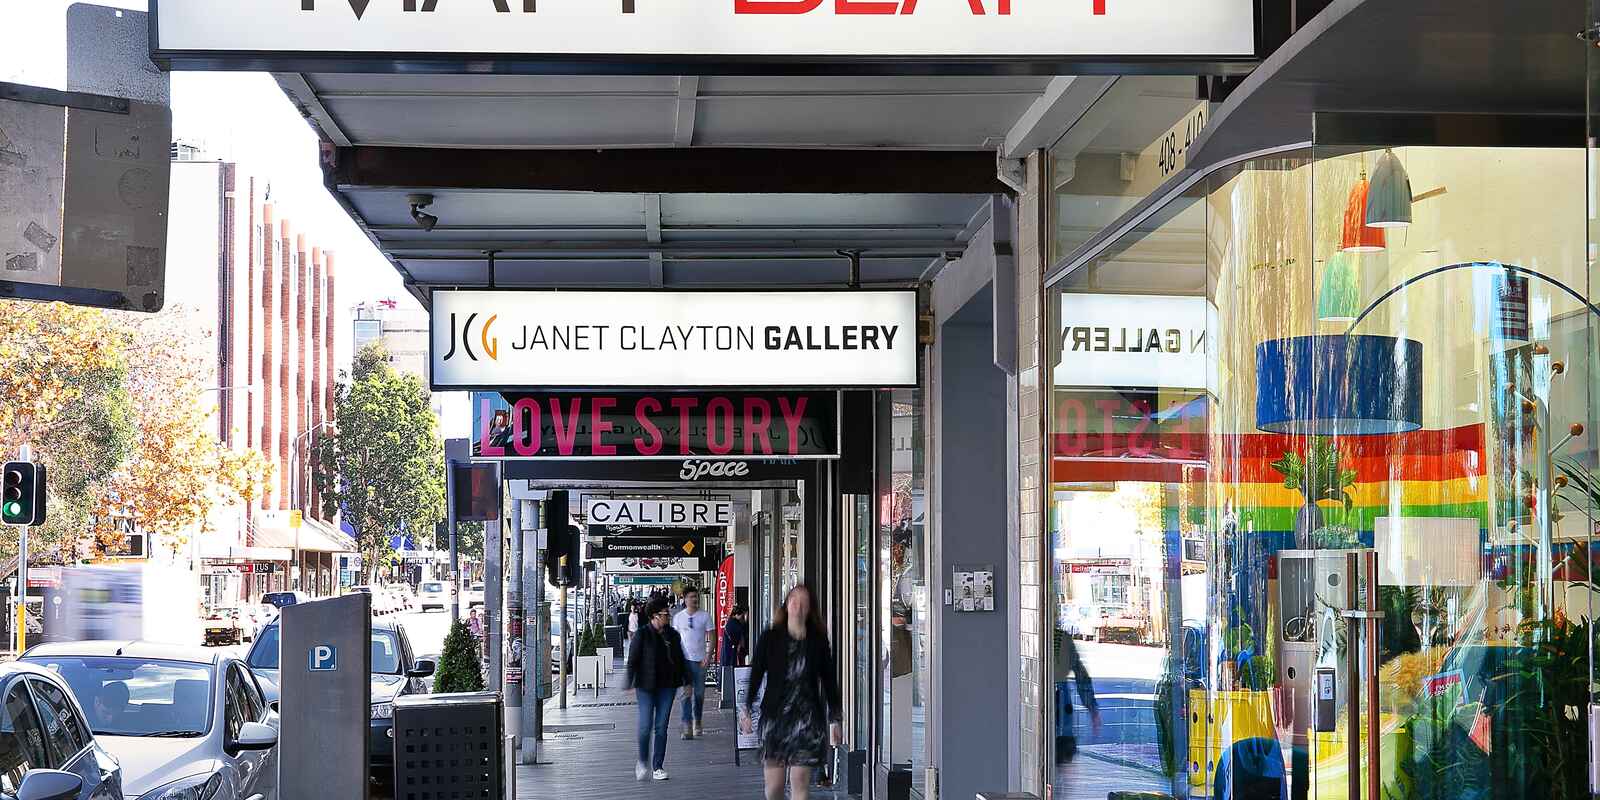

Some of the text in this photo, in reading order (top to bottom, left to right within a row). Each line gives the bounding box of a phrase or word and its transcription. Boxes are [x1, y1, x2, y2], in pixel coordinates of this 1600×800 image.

[1159, 131, 1176, 177] 408
[1184, 111, 1204, 148] 410
[511, 325, 610, 351] JANET
[619, 325, 755, 351] CLAYTON
[764, 325, 899, 351] GALLERY
[480, 396, 810, 457] LOVE STORY
[679, 459, 750, 480] Space
[591, 502, 729, 523] CALIBRE
[719, 571, 728, 607] SHOP
[314, 645, 332, 668] P
